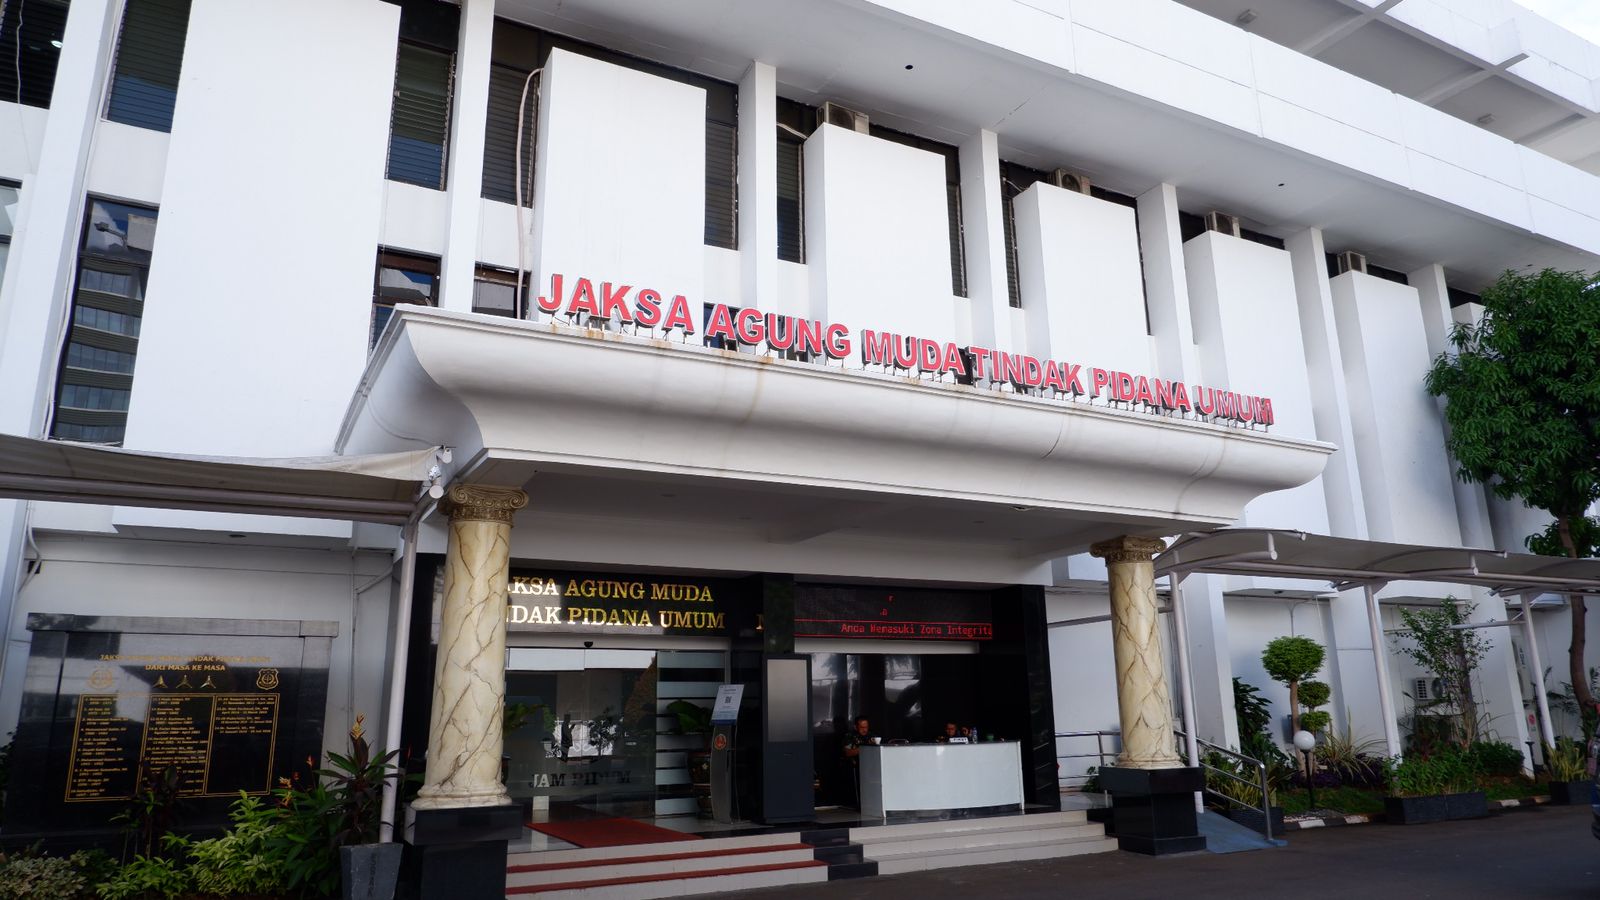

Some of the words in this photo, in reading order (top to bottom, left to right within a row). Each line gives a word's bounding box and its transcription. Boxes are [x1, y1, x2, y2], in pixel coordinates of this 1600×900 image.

[537, 273, 695, 335] JAKSA
[703, 303, 852, 359] AGUNG
[862, 328, 967, 377] MUDA
[967, 346, 1085, 397] TINDAK
[1087, 366, 1192, 412] PIDANA
[1192, 384, 1275, 426] UMUM
[507, 576, 560, 596] KSA
[564, 579, 645, 600] AGUNG
[650, 583, 714, 602] MUDA
[506, 605, 561, 625] DAK
[567, 607, 653, 627] PIDANA
[658, 610, 727, 629] UMUM
[529, 772, 567, 788] JAM
